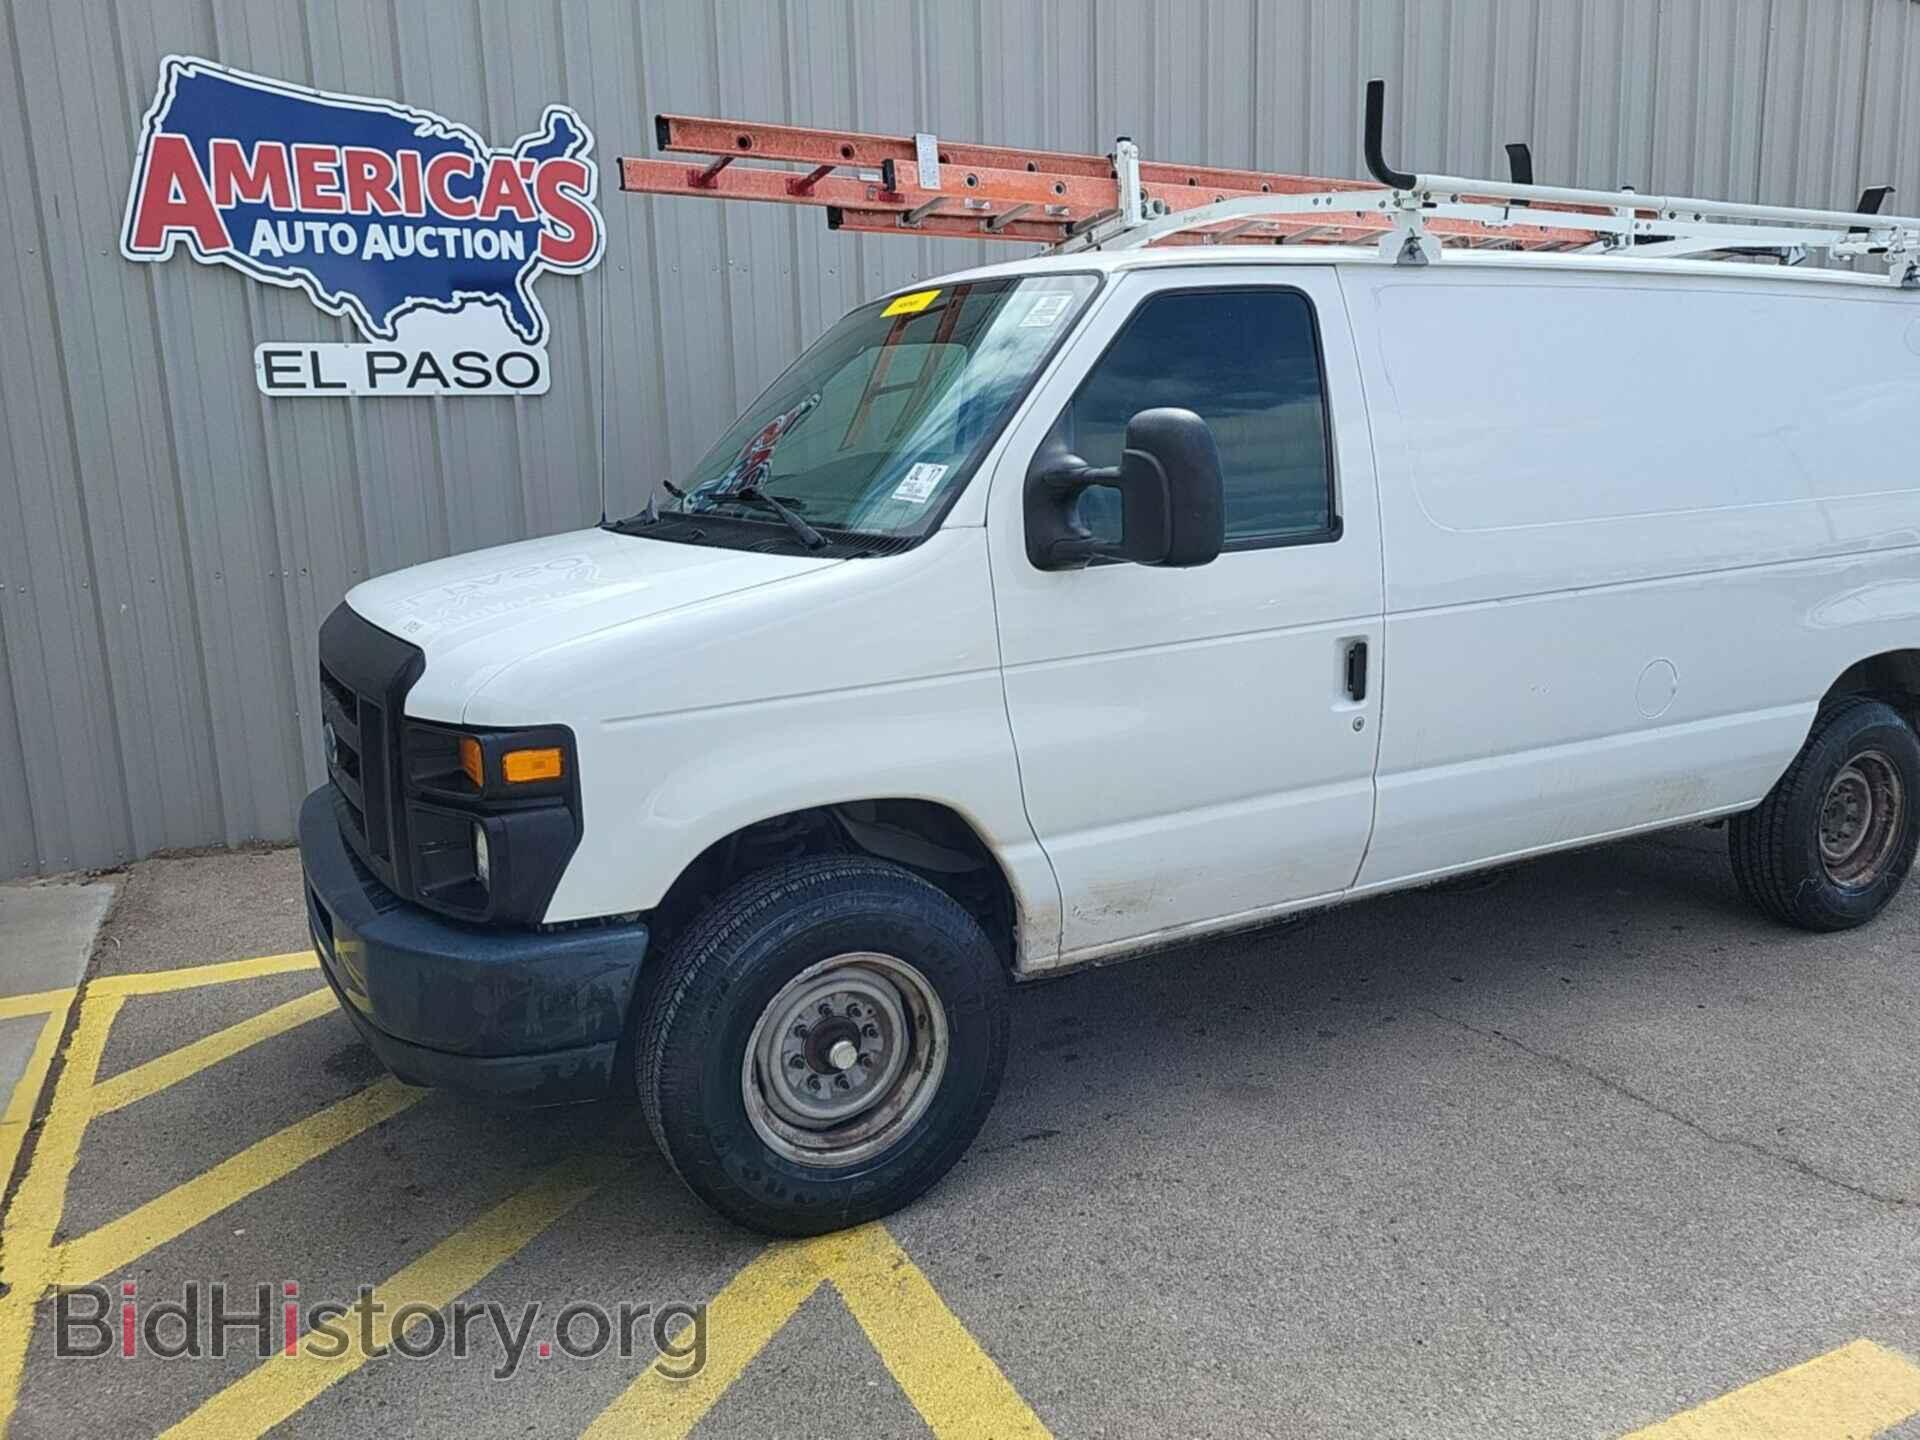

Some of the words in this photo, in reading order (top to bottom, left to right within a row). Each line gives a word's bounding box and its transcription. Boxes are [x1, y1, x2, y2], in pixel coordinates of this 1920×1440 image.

[131, 133, 597, 263] AMERICA'S
[249, 219, 357, 258] AUTO
[362, 225, 525, 261] AUCTION
[262, 351, 347, 390] EL
[365, 351, 541, 390] PASO
